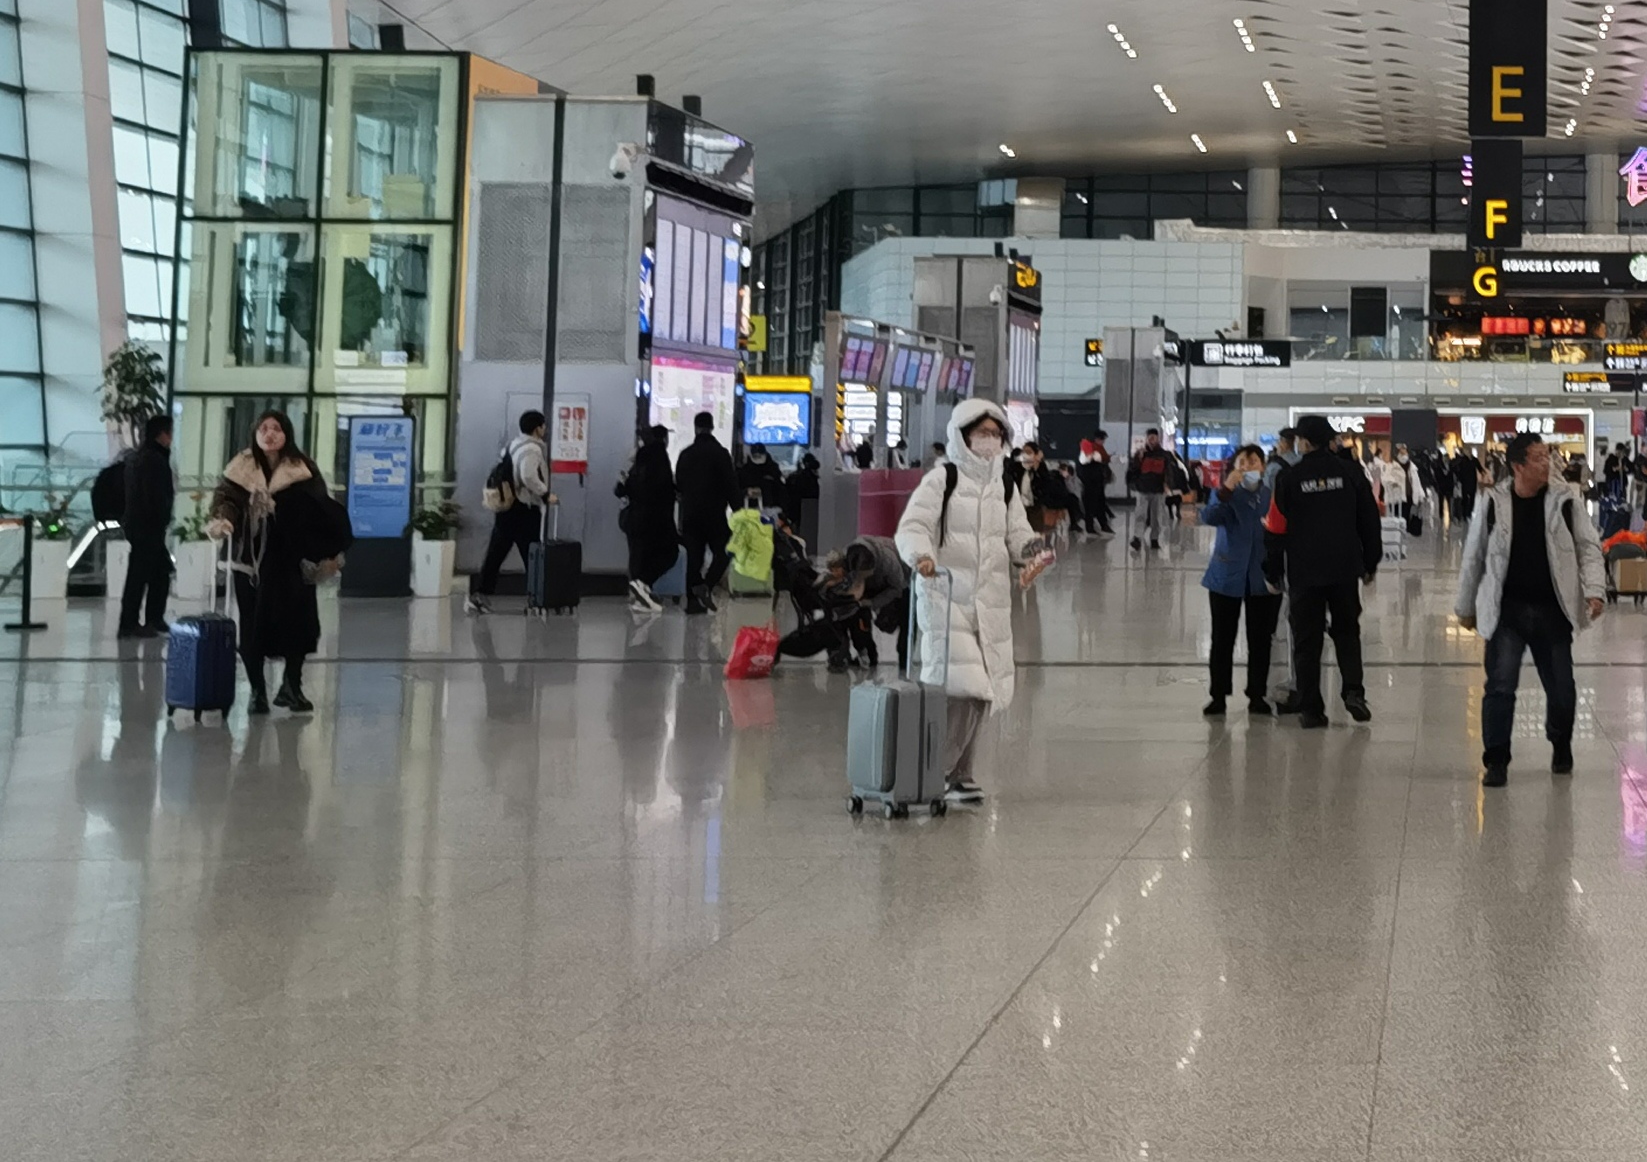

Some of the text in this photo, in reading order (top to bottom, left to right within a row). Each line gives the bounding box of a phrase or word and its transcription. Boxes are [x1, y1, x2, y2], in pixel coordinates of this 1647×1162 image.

[1492, 66, 1524, 122] E
[1485, 199, 1507, 239] F
[1473, 266, 1497, 297] G
